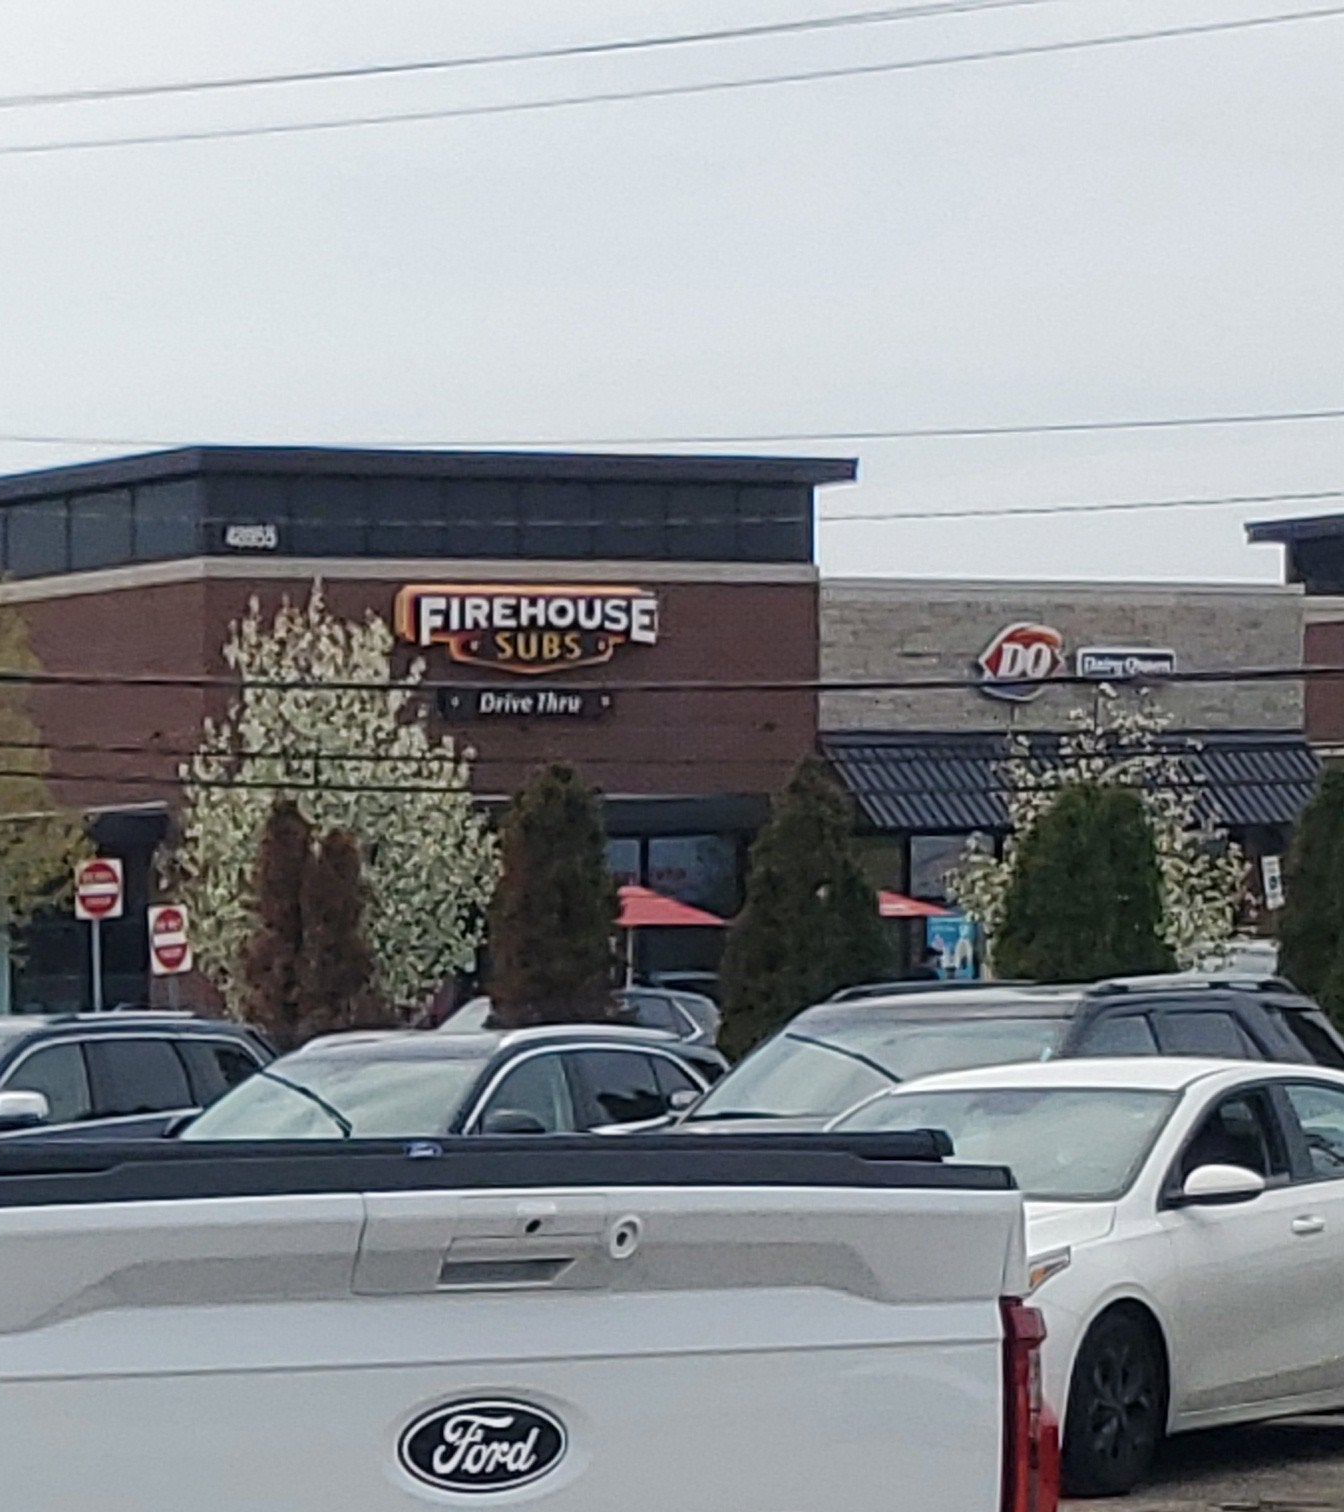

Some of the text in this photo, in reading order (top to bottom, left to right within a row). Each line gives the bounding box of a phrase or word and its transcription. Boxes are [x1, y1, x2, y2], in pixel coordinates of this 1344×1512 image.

[419, 596, 659, 646] FIREHOUSE
[494, 630, 583, 661] SUBS
[479, 691, 582, 714] Drive Thru
[431, 1411, 541, 1476] Ford
